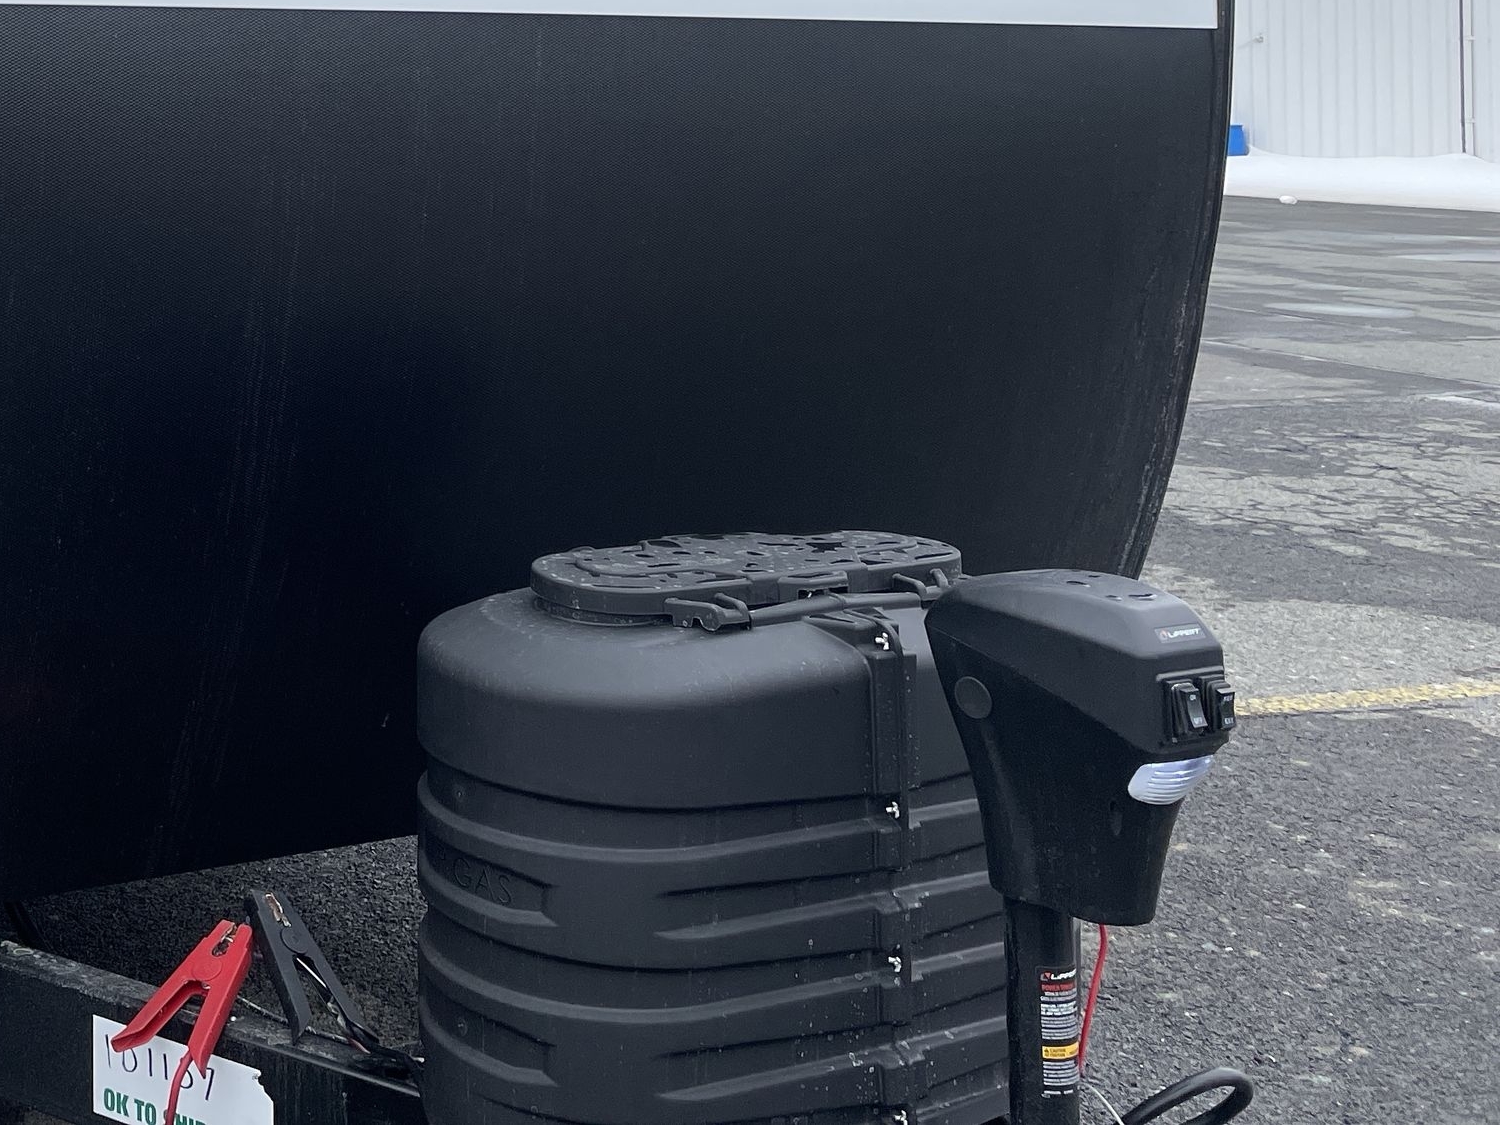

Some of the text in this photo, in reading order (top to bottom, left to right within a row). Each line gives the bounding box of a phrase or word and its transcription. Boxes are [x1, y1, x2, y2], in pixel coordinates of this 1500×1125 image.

[453, 857, 512, 906] GAS
[103, 1088, 130, 1118] OK
[134, 1098, 157, 1125] TO
